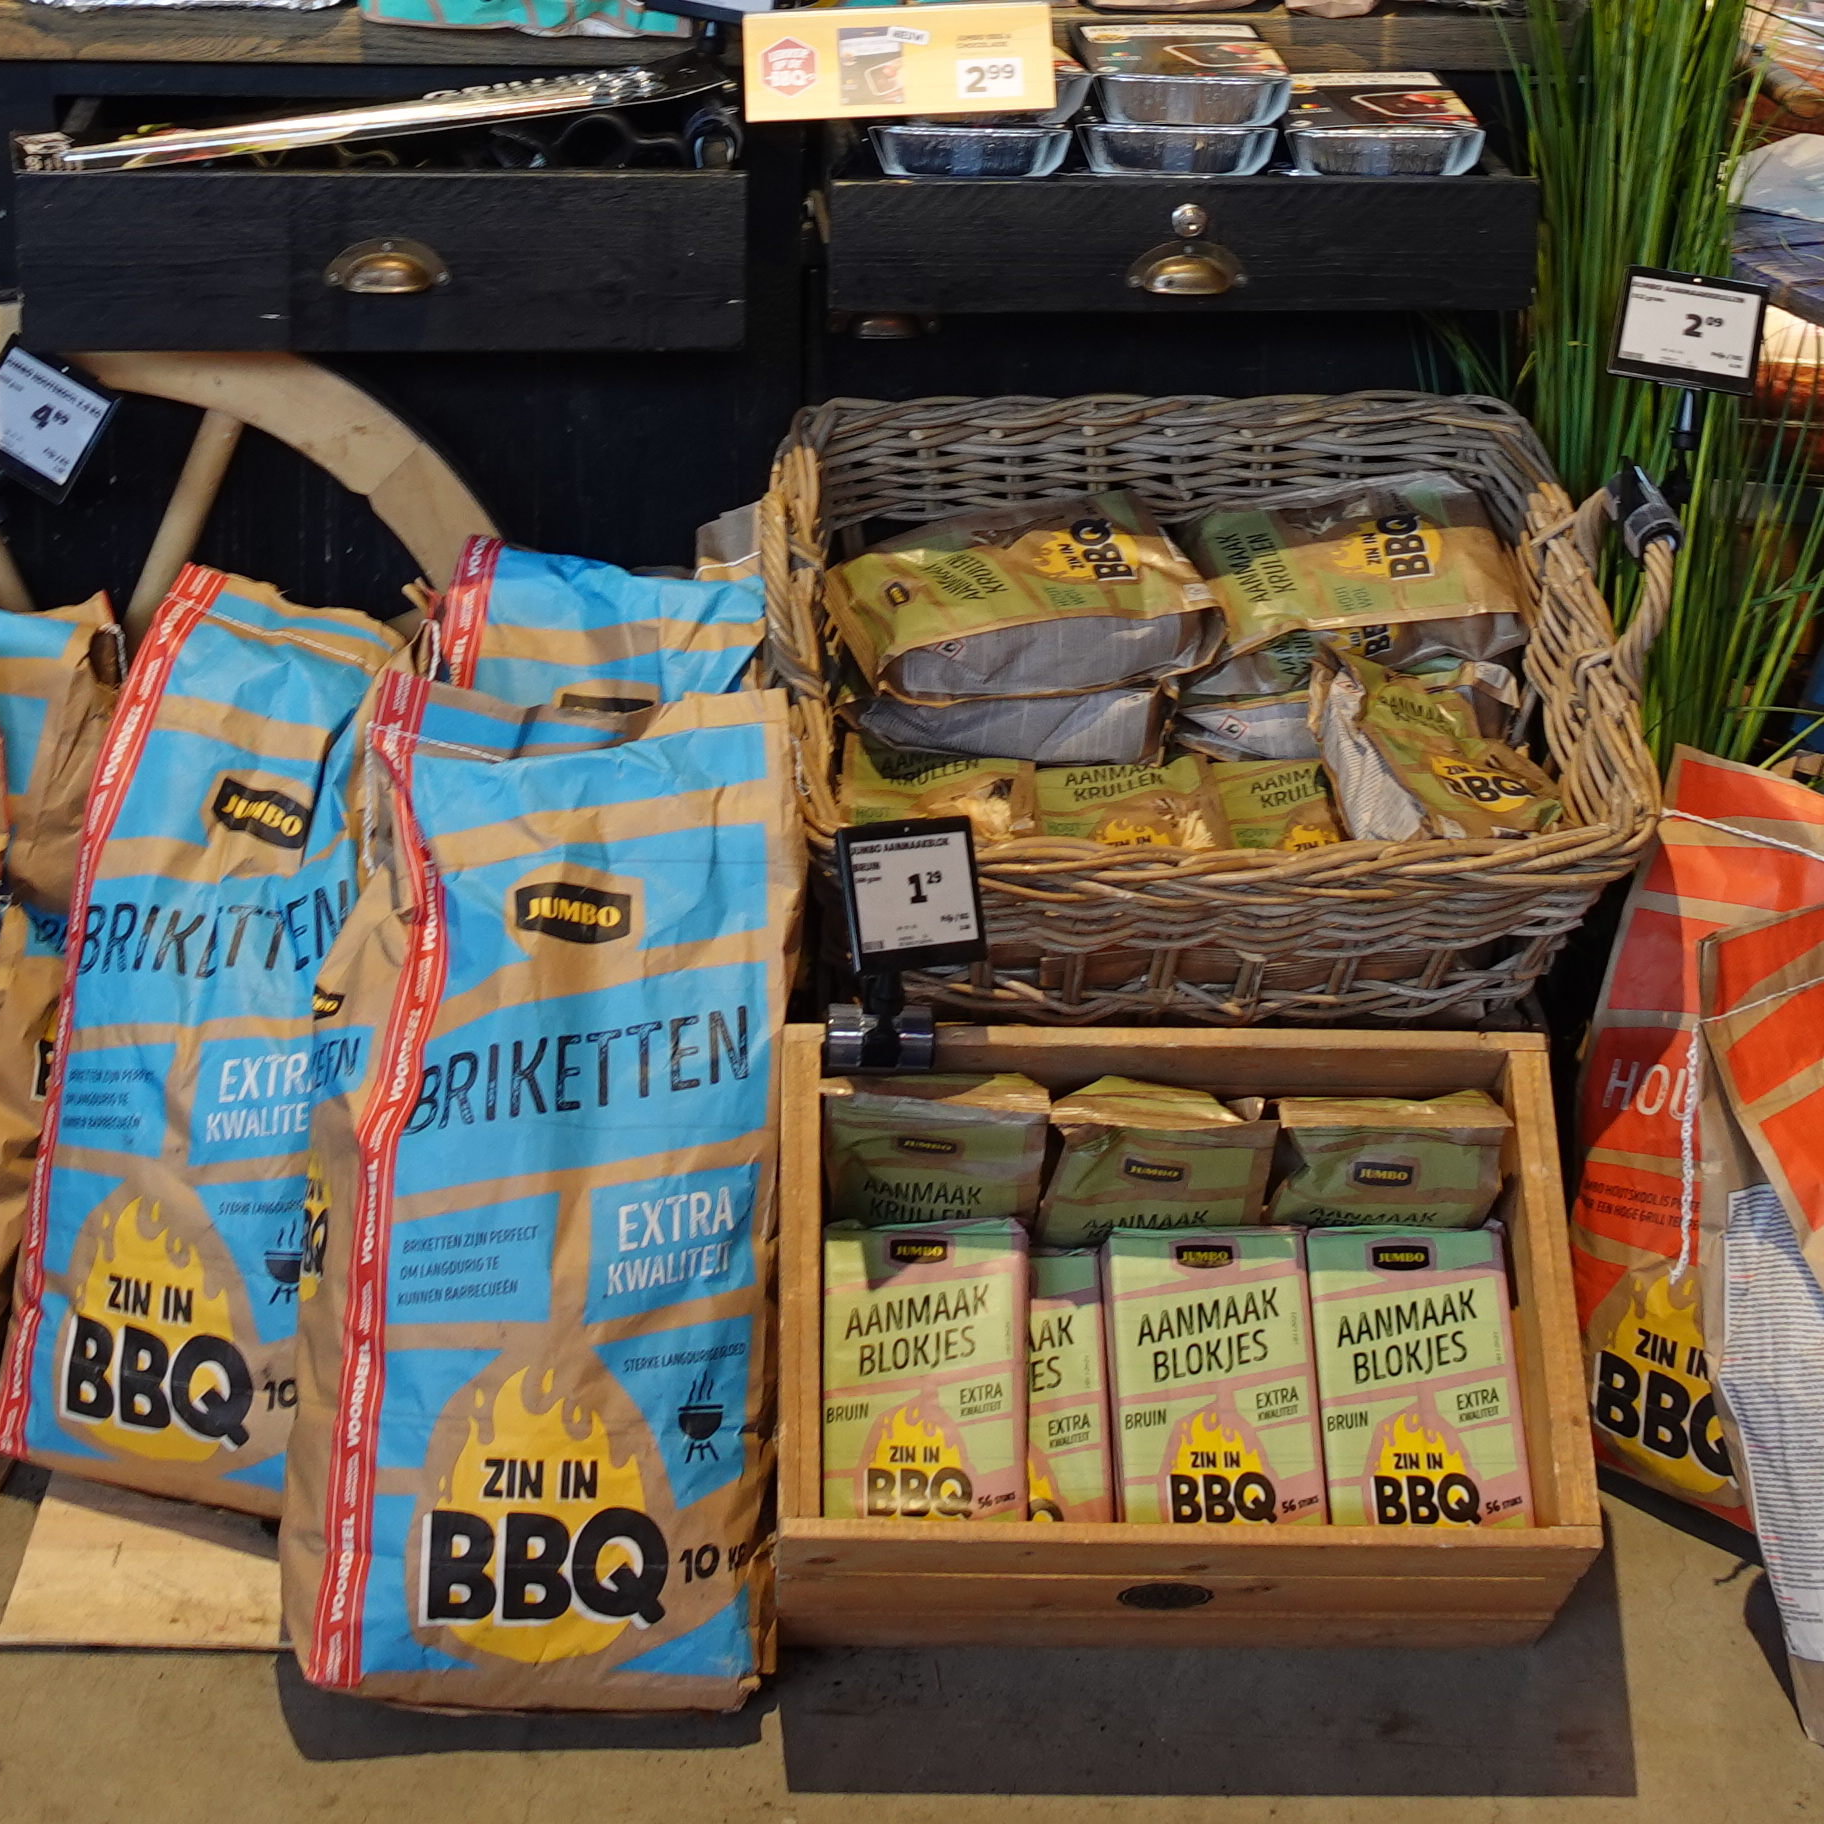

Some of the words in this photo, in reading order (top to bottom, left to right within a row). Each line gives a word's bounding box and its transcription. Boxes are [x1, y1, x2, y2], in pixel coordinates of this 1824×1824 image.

[1069, 518, 1139, 582] BBQ
[1215, 531, 1273, 604] AANMAAK
[1255, 530, 1297, 595] KRULLEN
[1377, 514, 1435, 581] BBQ
[1073, 772, 1165, 802] KRULLEN
[220, 793, 304, 839] JUMBO
[77, 879, 351, 979] BRIKETTEN
[524, 894, 622, 928] JUMBO
[399, 1005, 751, 1136] BRIKETTEN
[863, 1178, 983, 1207] AANMAAK
[1359, 1167, 1411, 1182] JUMBO
[402, 1233, 463, 1254] BRIKETTEN
[489, 1223, 538, 1245] PERFECT
[617, 1186, 736, 1252] EXTRA
[607, 1240, 734, 1297] KWALITEIT
[895, 1243, 944, 1259] JUMBO
[1180, 1249, 1230, 1264] JUMBO
[1377, 1249, 1427, 1265] JUMBO
[107, 1272, 152, 1318] ZIN
[161, 1283, 195, 1325] IN
[844, 1283, 990, 1341] AANMAAK
[1137, 1286, 1281, 1347] AANMAAK
[1336, 1288, 1479, 1349] AANMAAK
[859, 1325, 977, 1378] BLOKJES
[1152, 1328, 1269, 1383] BLOKJES
[1353, 1330, 1469, 1385] BLOKJES
[1635, 1329, 1678, 1369] ZIN
[59, 1312, 254, 1453] BBQ
[346, 1339, 372, 1449] VOORDEEL
[959, 1381, 1004, 1405] EXTRA
[1255, 1387, 1300, 1411] EXTRA
[1455, 1387, 1501, 1413] EXTRA
[825, 1402, 869, 1424] BRUIN
[1047, 1413, 1091, 1438] EXTRA
[1124, 1407, 1167, 1431] BRUIN
[1326, 1409, 1370, 1433] BRUIN
[889, 1445, 919, 1464] ZIN
[922, 1445, 940, 1464] IN
[1189, 1450, 1218, 1469] ZIN
[1222, 1450, 1242, 1469] IN
[1392, 1451, 1421, 1470] ZIN
[1425, 1451, 1444, 1470] IN
[479, 1457, 546, 1503] ZIN
[557, 1459, 598, 1502] IN
[863, 1467, 975, 1520] BBQ
[1167, 1471, 1278, 1525] BBQ
[1370, 1473, 1483, 1527] BBQ
[329, 1512, 357, 1624] VOORDEEL
[418, 1505, 669, 1632] BBQ
[678, 1545, 720, 1584] 10
